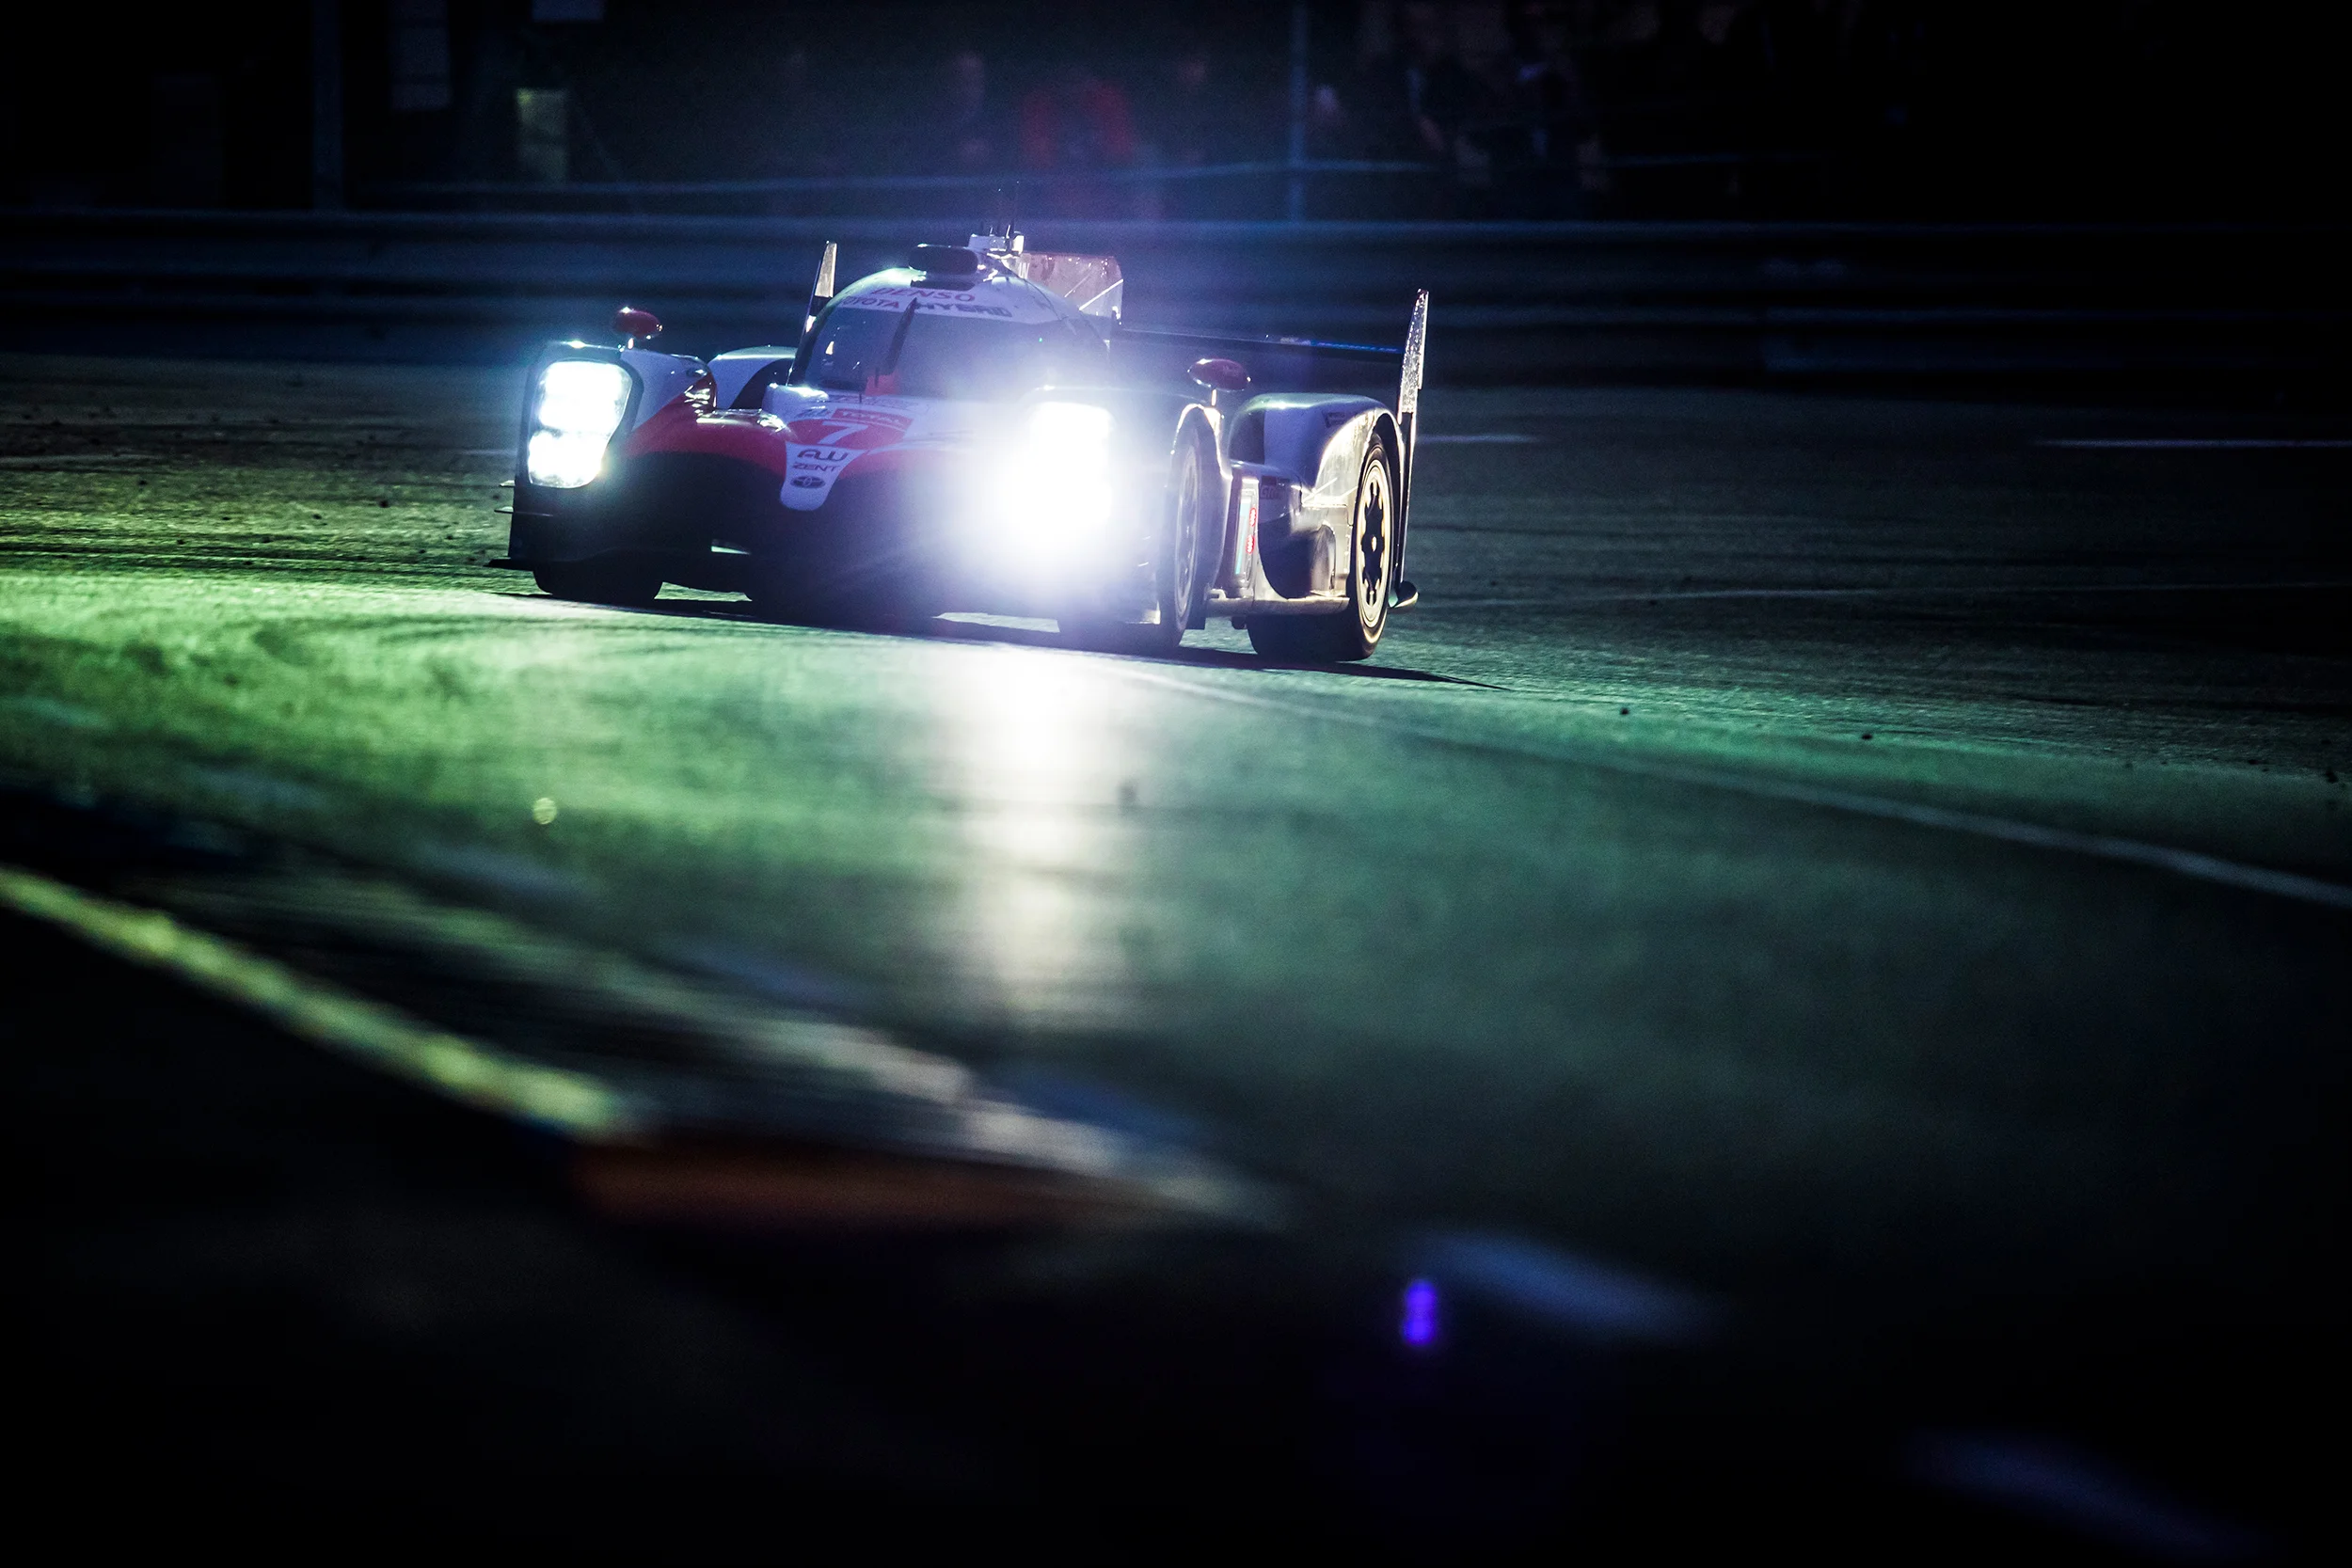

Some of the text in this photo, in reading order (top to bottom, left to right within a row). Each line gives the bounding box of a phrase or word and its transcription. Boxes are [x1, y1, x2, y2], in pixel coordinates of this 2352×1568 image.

[839, 295, 899, 308] OYOTA
[871, 288, 976, 302] DENSO
[818, 420, 868, 444] 7
[792, 462, 841, 472] ZENT
